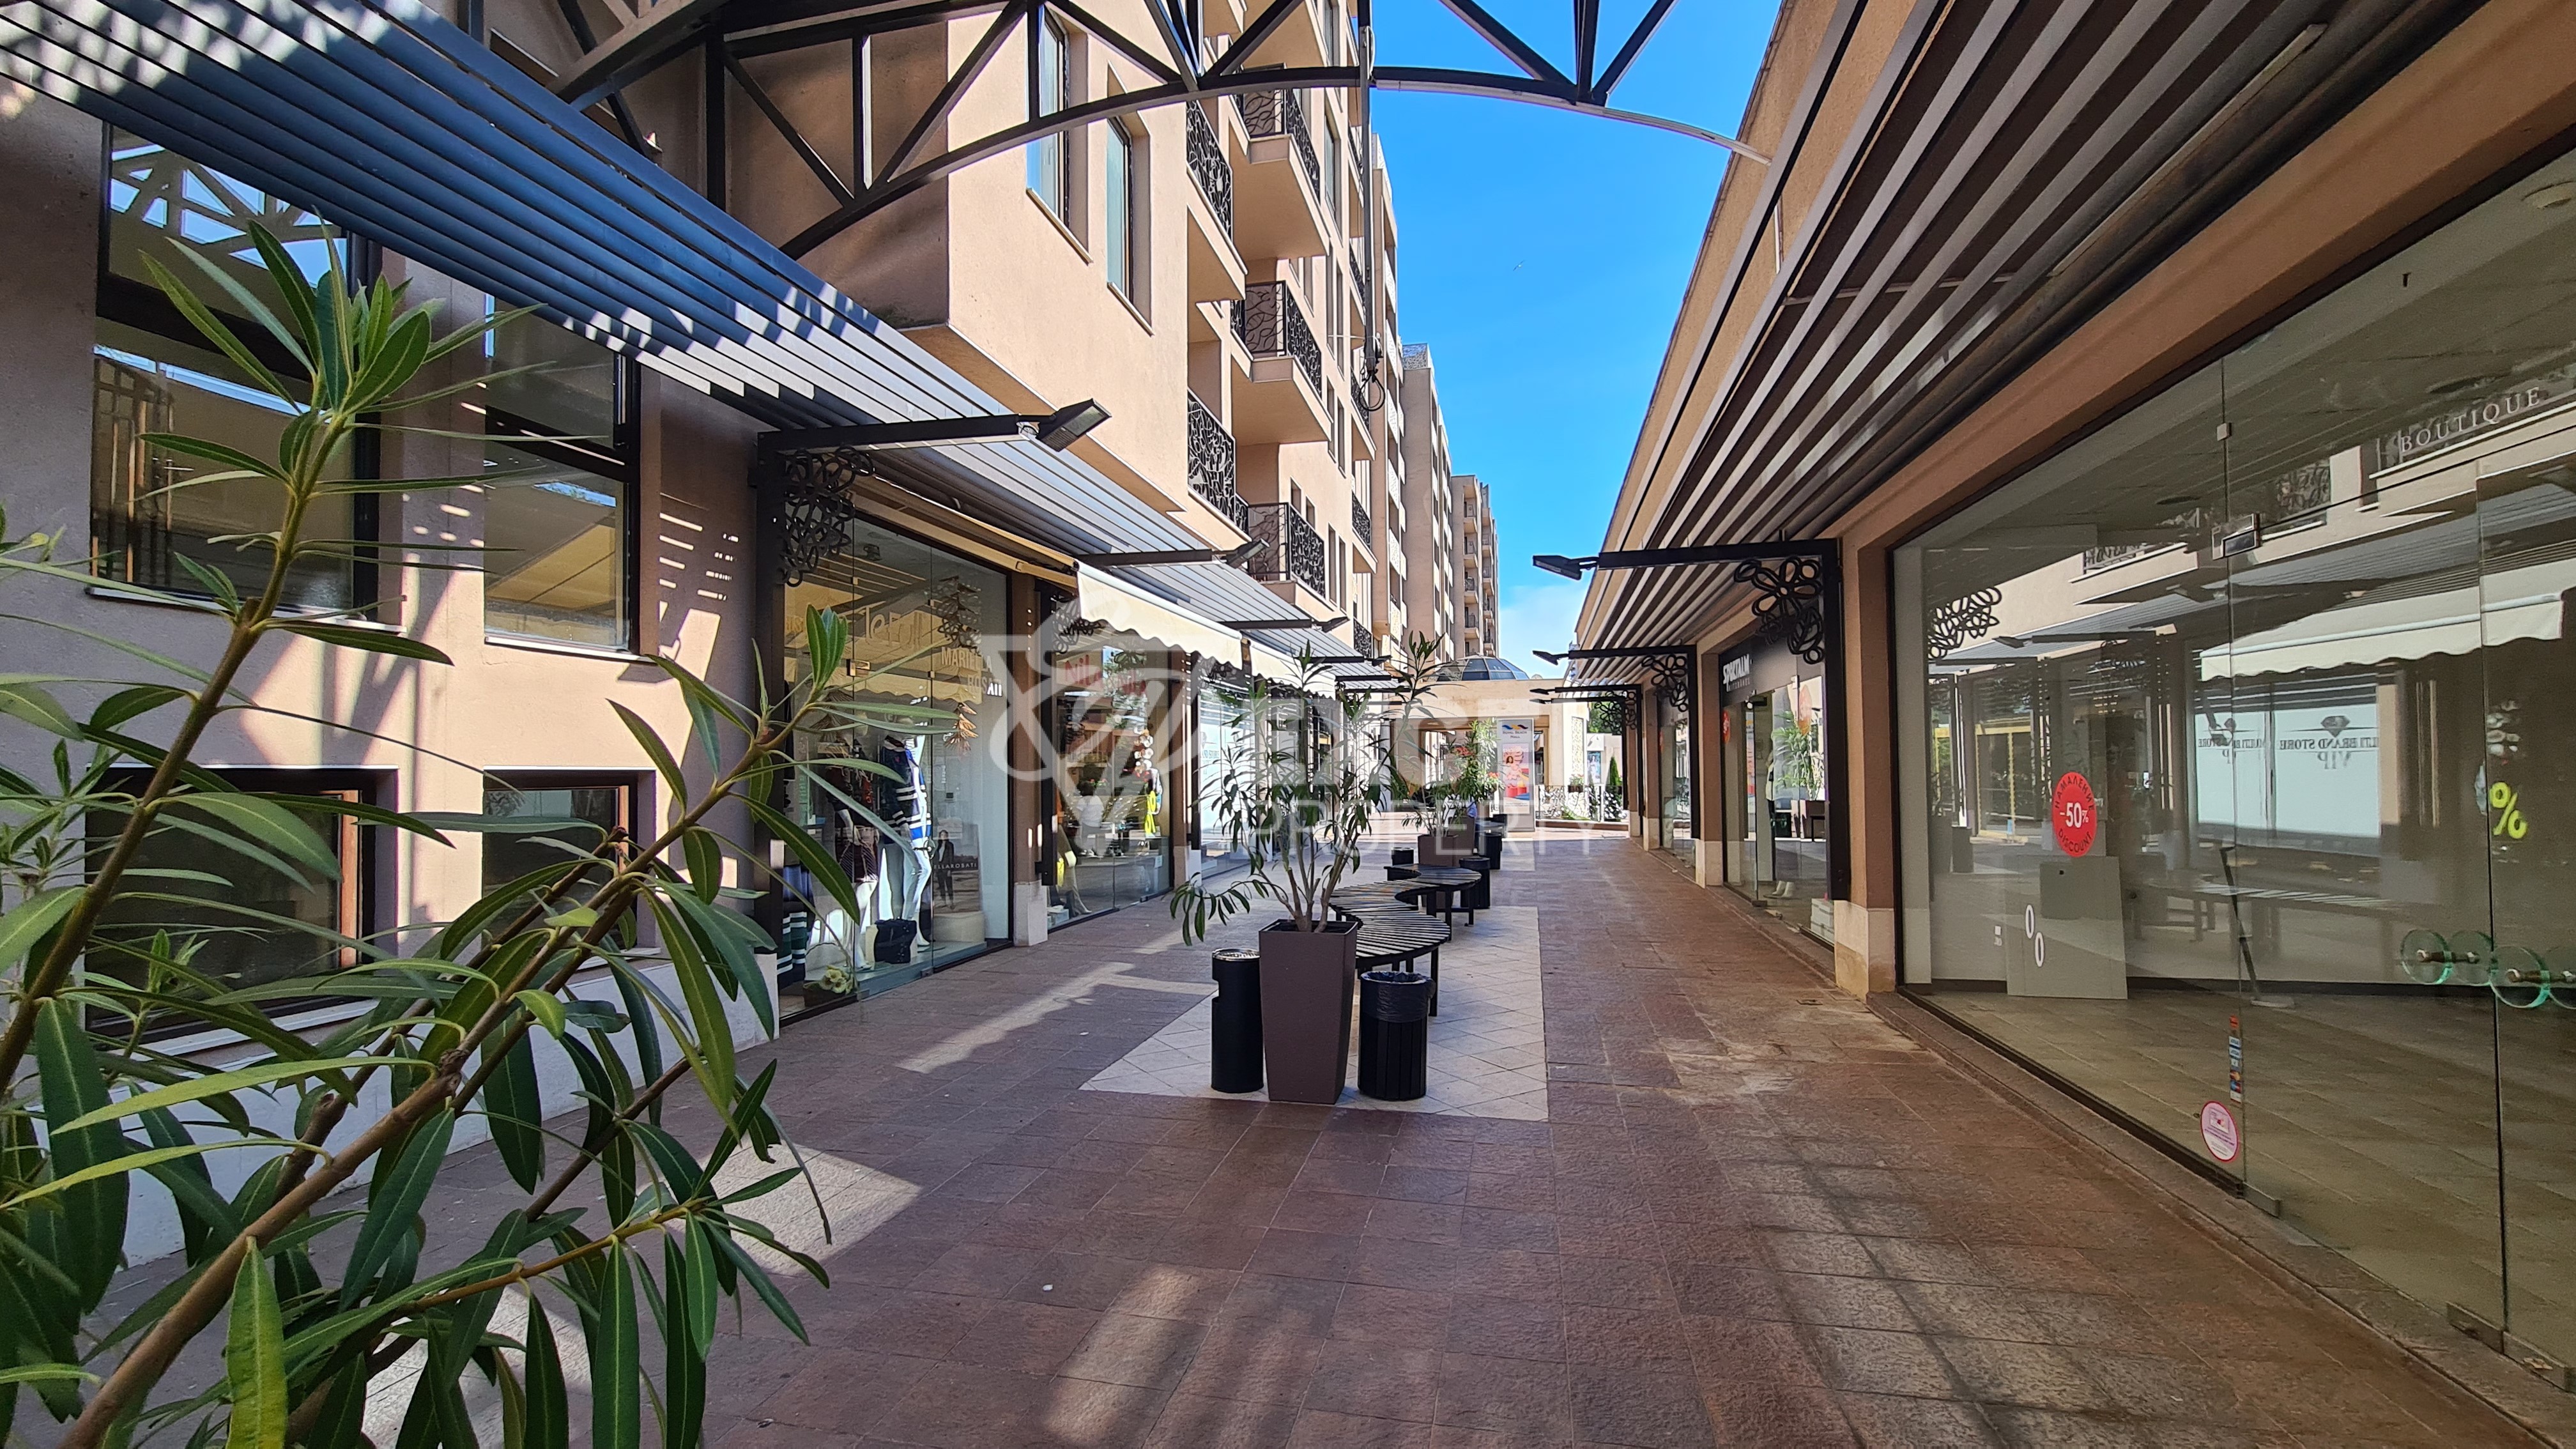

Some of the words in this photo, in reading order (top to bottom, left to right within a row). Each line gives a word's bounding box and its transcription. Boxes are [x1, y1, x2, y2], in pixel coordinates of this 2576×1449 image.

[2400, 386, 2541, 453] BOUTIQUE
[941, 646, 993, 673] MARIELLA
[2055, 775, 2095, 810] НАМАЛЕНИЕ
[2059, 802, 2089, 828] -50%
[2058, 828, 2092, 852] DISCOUNT
